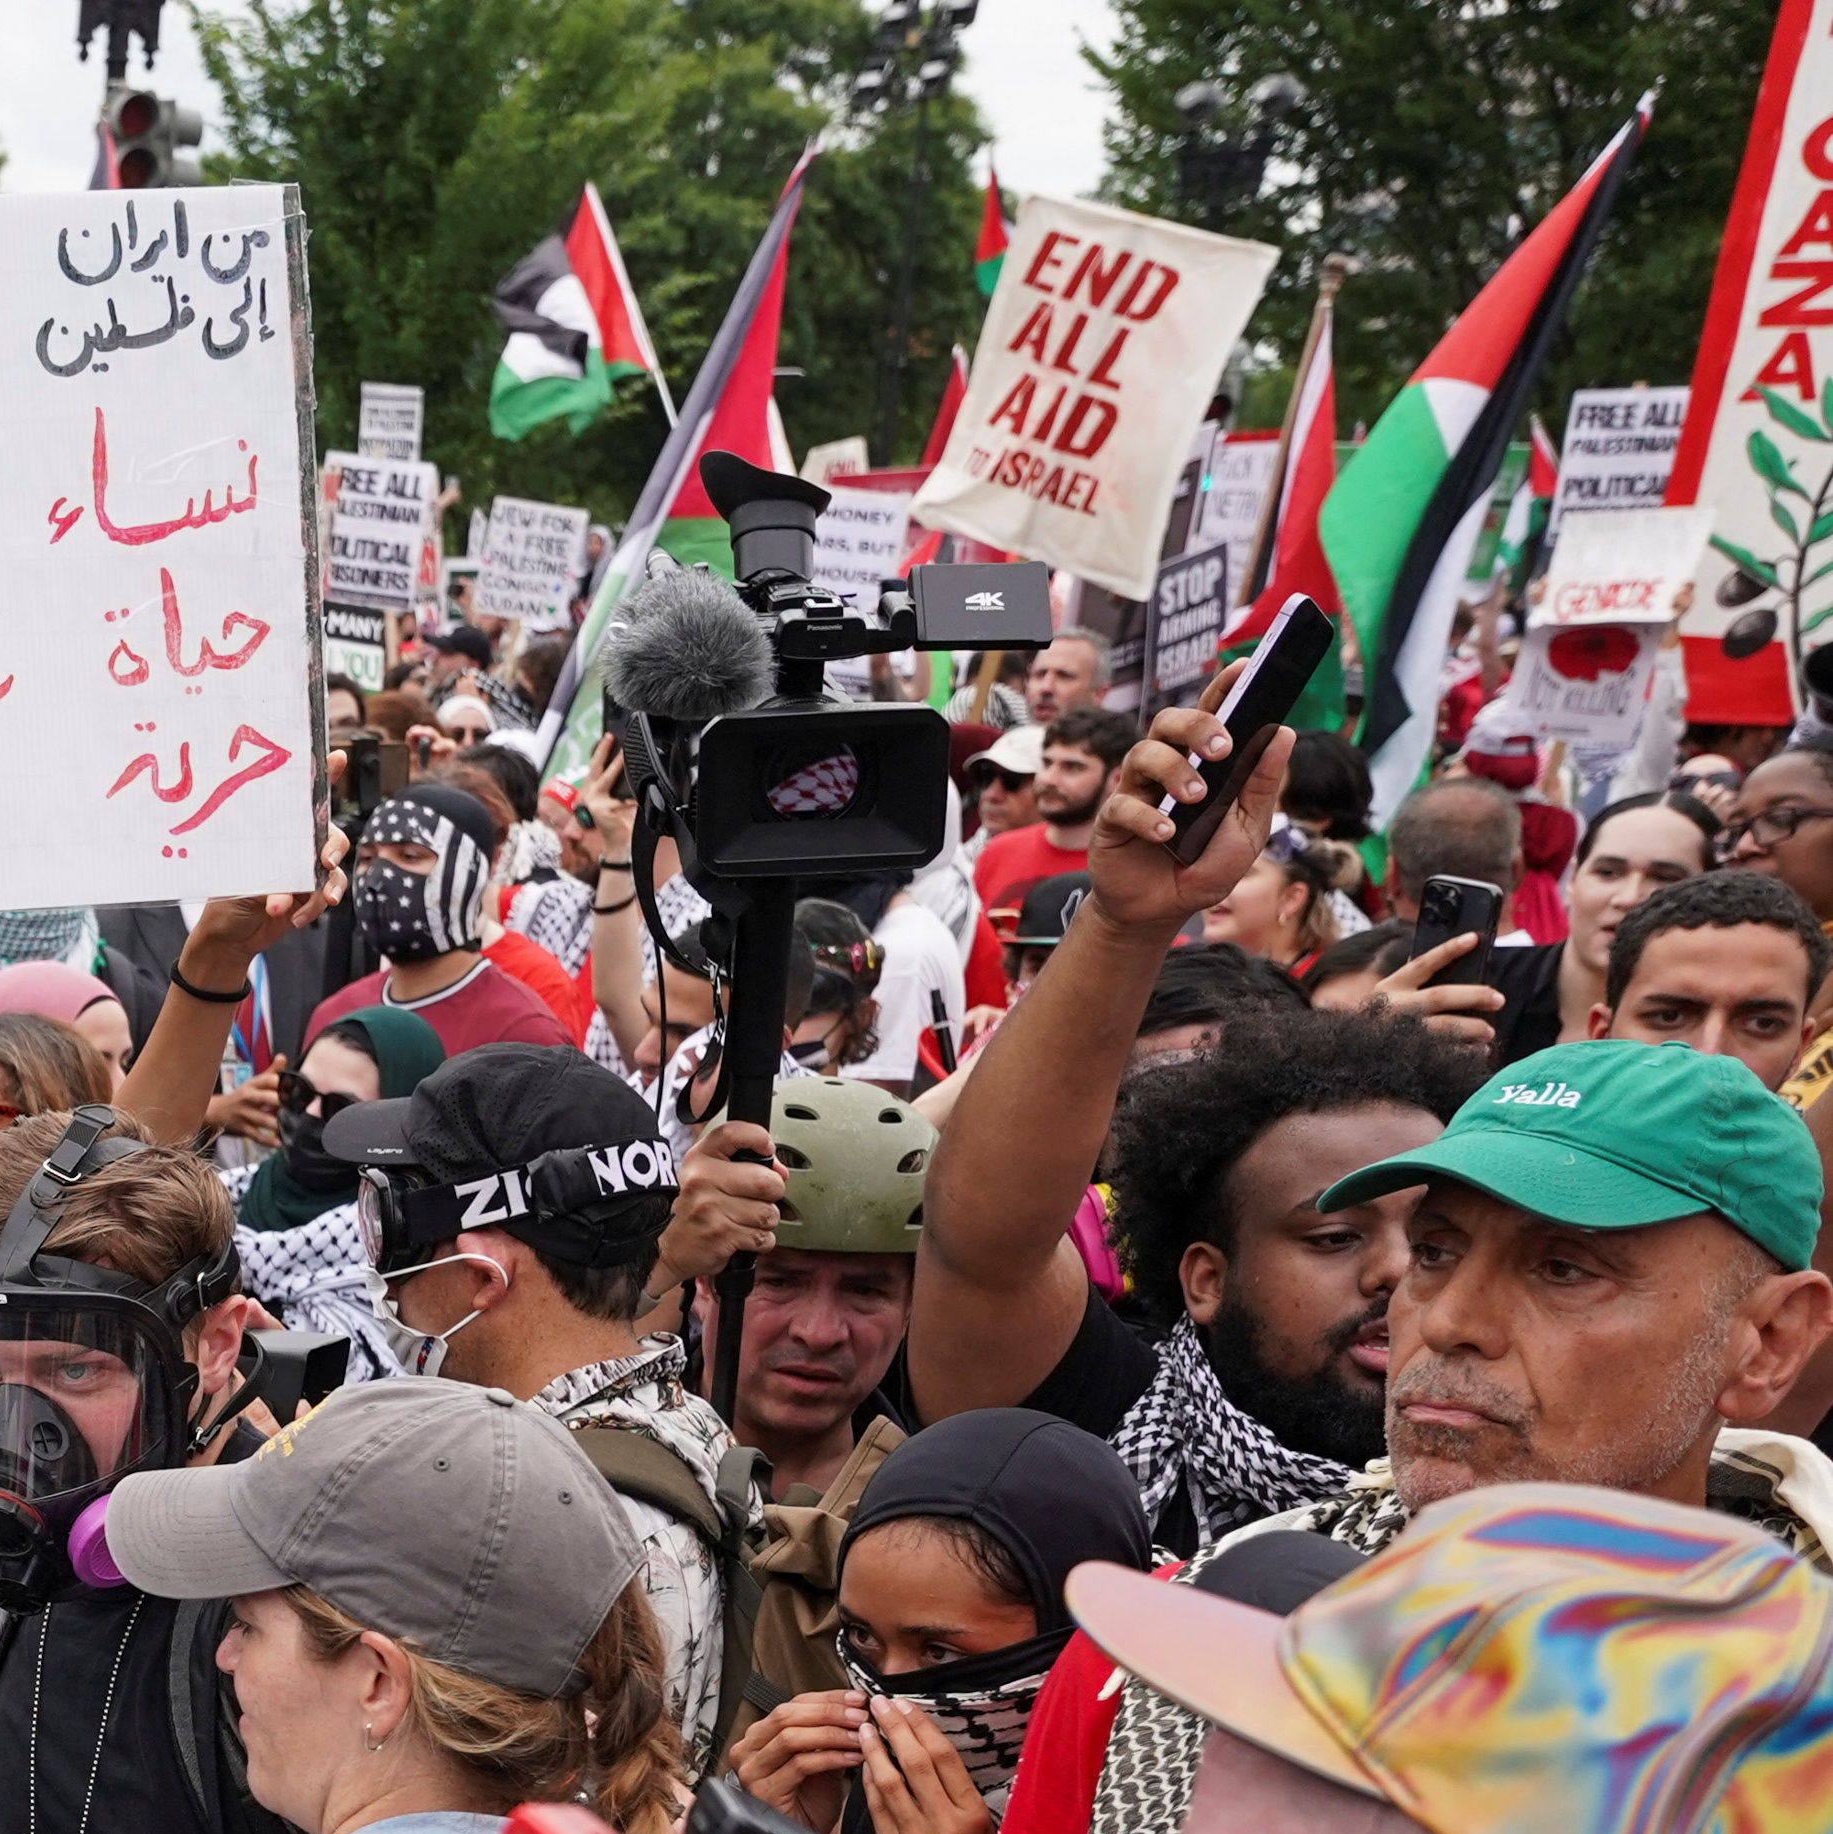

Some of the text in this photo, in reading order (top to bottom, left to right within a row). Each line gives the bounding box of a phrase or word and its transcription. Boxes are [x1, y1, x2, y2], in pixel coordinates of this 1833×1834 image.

[201, 229, 271, 285] من
[1023, 231, 1180, 324] END
[1006, 301, 1132, 392] ALL
[988, 372, 1119, 461] AID
[1574, 401, 1683, 428] FREE ALL
[47, 406, 258, 546] نساء
[339, 467, 423, 500] REE ALL
[963, 447, 1100, 517] TO ISRAEL
[964, 591, 1005, 606] 4K
[1159, 555, 1225, 617] STOP
[326, 609, 384, 643] MANY
[806, 623, 844, 632] Panasonic
